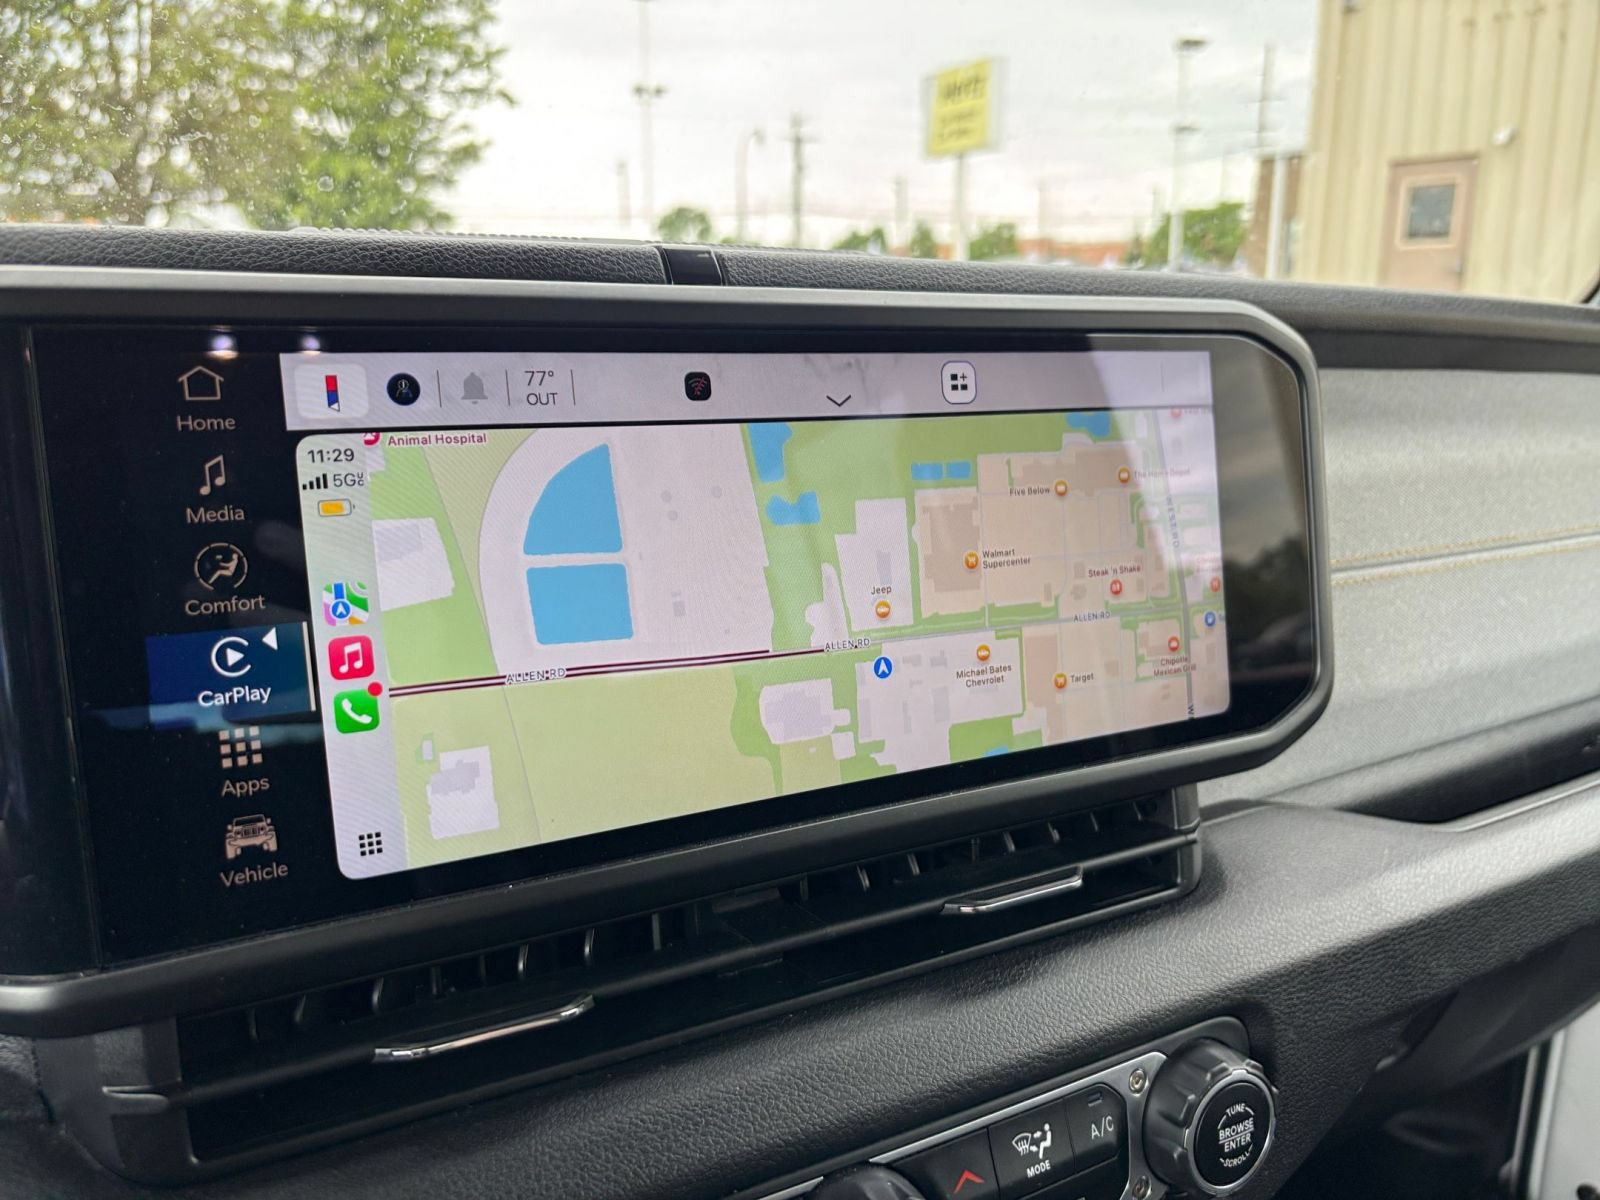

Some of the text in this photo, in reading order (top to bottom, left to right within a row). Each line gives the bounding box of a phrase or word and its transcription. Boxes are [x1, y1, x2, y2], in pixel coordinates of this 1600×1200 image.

[526, 392, 558, 406] OUT
[176, 415, 236, 432] Home
[387, 432, 487, 447] Animal Hospital
[307, 448, 355, 464] 11:29
[1009, 486, 1050, 496] Five Below
[186, 505, 245, 524] Media
[982, 549, 1015, 559] Walmart
[982, 557, 1031, 570] Supercenter
[1088, 568, 1109, 578] Steak
[1119, 565, 1141, 575] Shake
[870, 585, 892, 596] Jeep
[185, 595, 266, 616] Comfort
[1073, 612, 1098, 622] ALLEN
[825, 638, 870, 650] ALLEN RD
[1160, 656, 1188, 666] Chipotle
[506, 668, 566, 682] ALLEN RD
[956, 664, 1012, 680] Michael Bates
[1070, 673, 1094, 683] Target
[1153, 666, 1182, 677] Mexican
[965, 675, 1004, 688] Chevrolet
[198, 685, 271, 707] CarPlay
[221, 777, 270, 797] Apps
[220, 863, 288, 887] Vehicle
[1226, 1103, 1245, 1117] TUNE
[1090, 1115, 1114, 1140] A/C
[1219, 1117, 1254, 1140] BROWSE
[1224, 1132, 1251, 1153] ENTER
[1223, 1151, 1250, 1168] SCROLL
[1026, 1160, 1051, 1178] MODE
